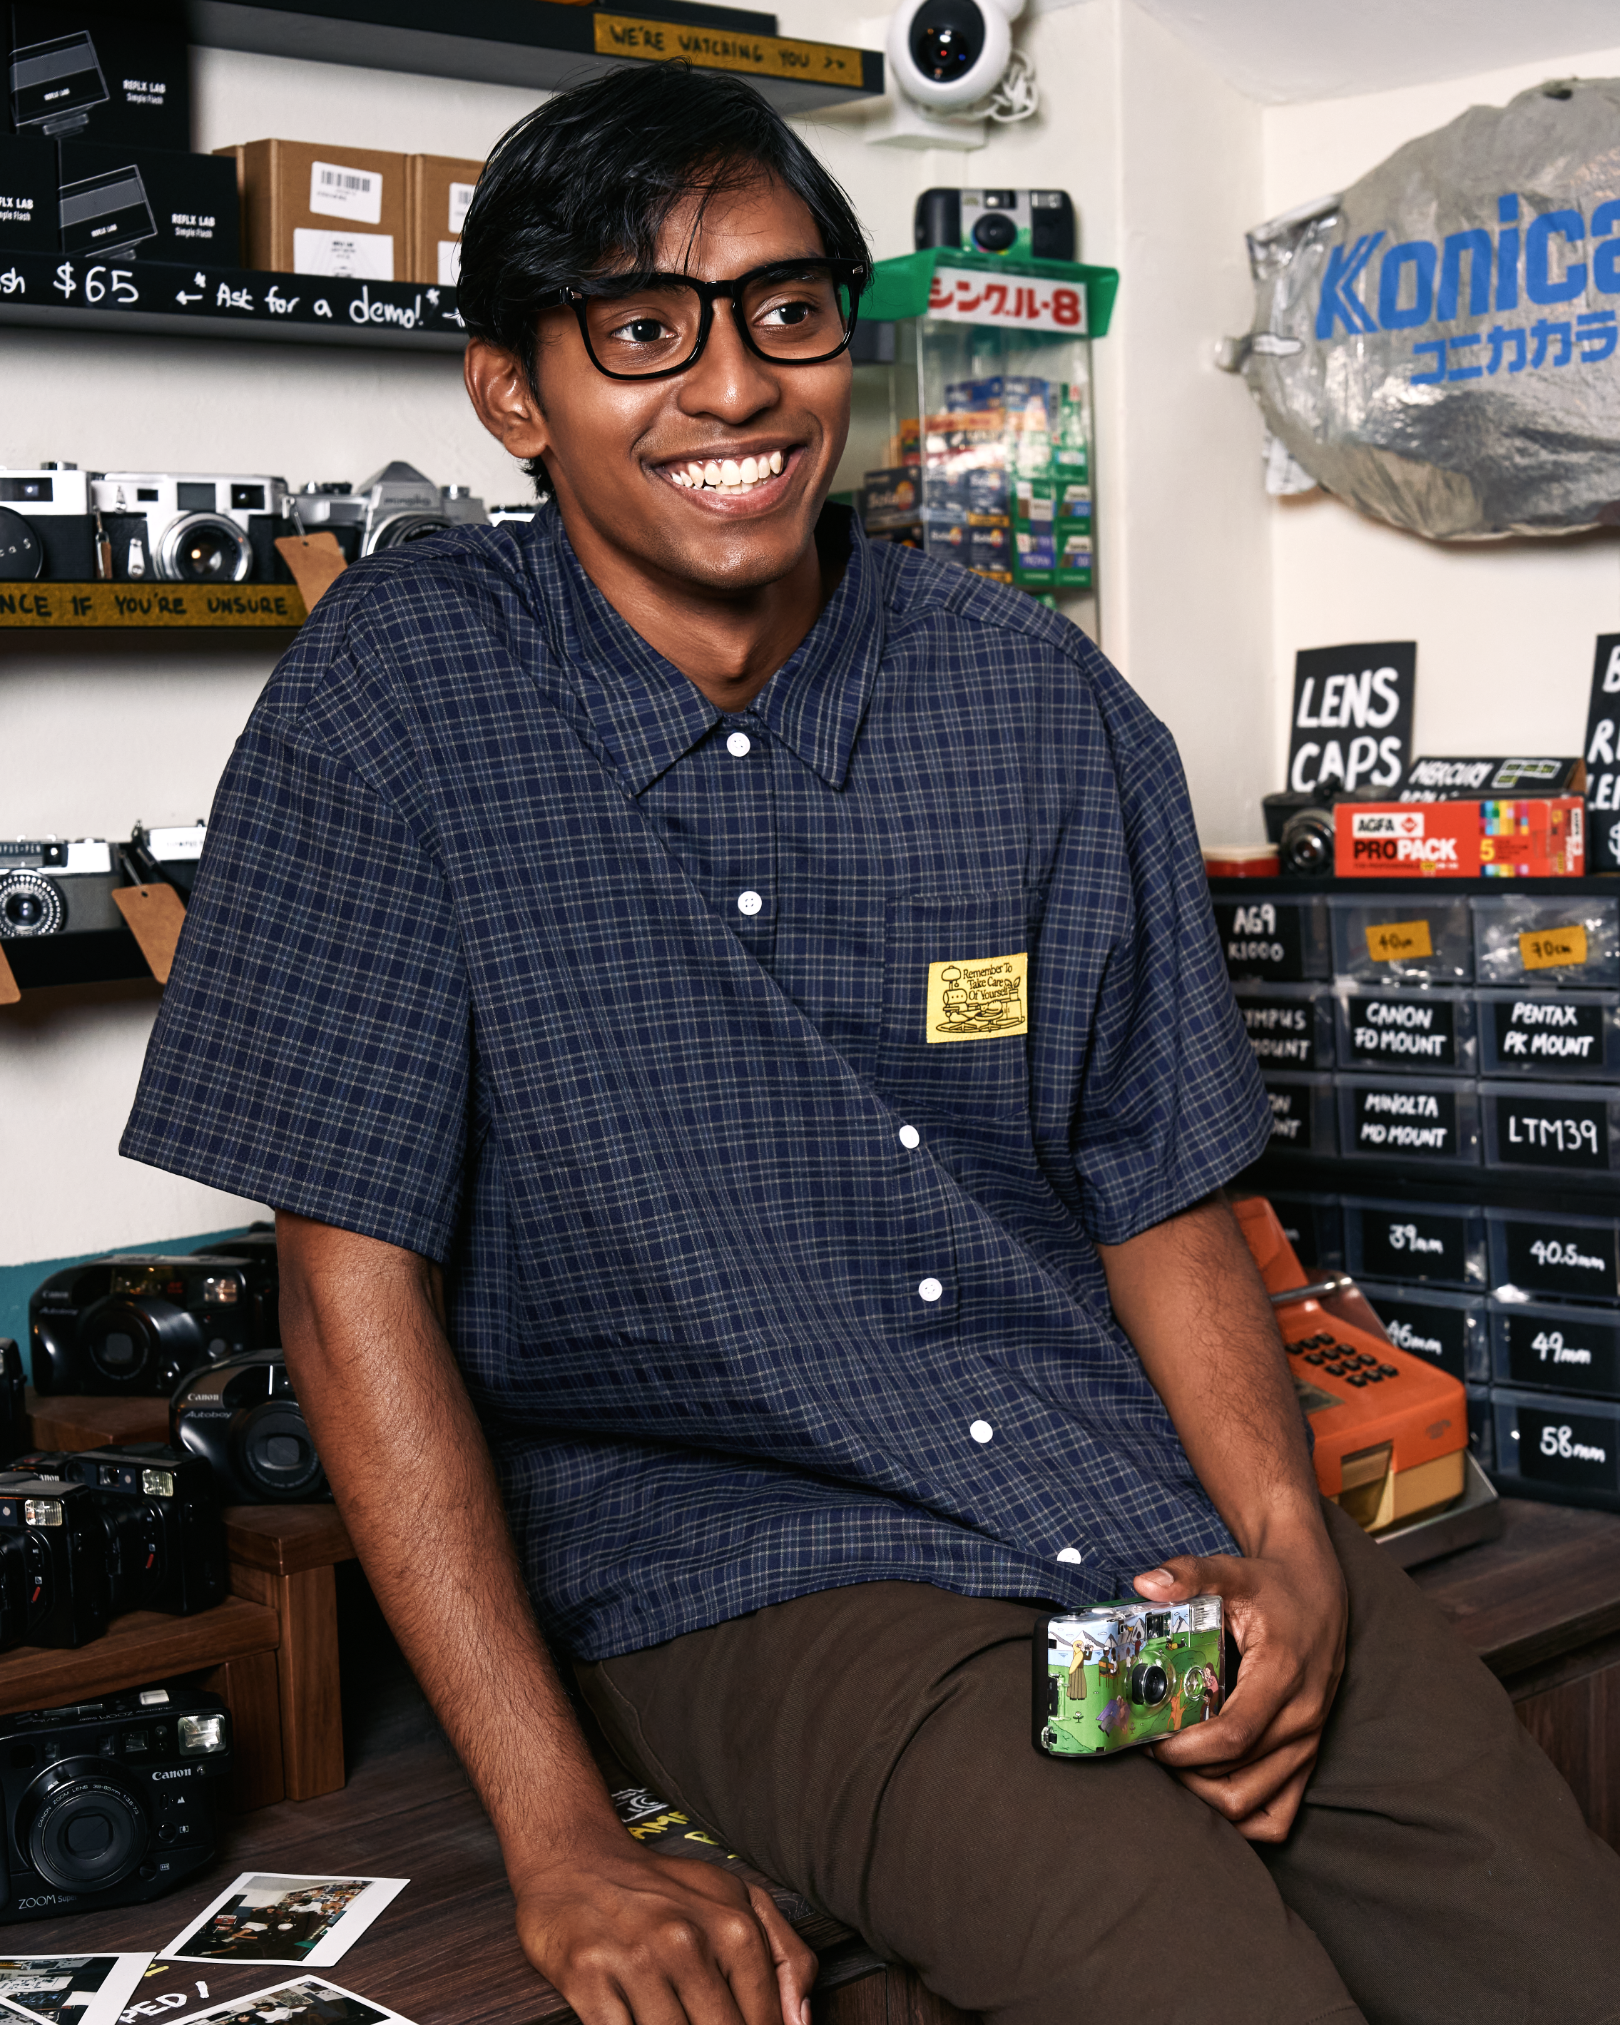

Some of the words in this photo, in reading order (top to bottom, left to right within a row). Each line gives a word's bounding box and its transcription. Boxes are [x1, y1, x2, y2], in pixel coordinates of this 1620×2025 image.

[678, 35, 763, 63] WATCHING
[778, 48, 810, 68] YOU
[53, 262, 140, 304] $65
[264, 286, 301, 316] for
[313, 299, 333, 319] a
[70, 595, 93, 617] IF
[114, 592, 188, 616] YOU'RE
[207, 596, 288, 616] UNSURE
[1296, 666, 1400, 729] LENS
[1291, 735, 1402, 793] CAPS
[1357, 818, 1396, 833] AGFA
[1353, 837, 1458, 862] PROPACK
[1480, 838, 1496, 862] 5
[963, 965, 1003, 980] Remember
[1004, 962, 1012, 973] To
[967, 978, 987, 990] Take
[987, 976, 1004, 988] Care
[968, 989, 980, 1001] Of
[1366, 1002, 1434, 1030] CANON
[1511, 1001, 1578, 1028] PENTAX
[1354, 1026, 1379, 1050] FD
[1380, 1029, 1448, 1058] MOUNT
[1504, 1030, 1529, 1055] PK
[1531, 1032, 1594, 1058] MOUNT
[1364, 1093, 1440, 1120] MINOLTA
[1360, 1122, 1386, 1144] MD
[1387, 1124, 1448, 1149] MOUNT
[1509, 1115, 1598, 1155] LTM39
[1529, 1239, 1606, 1272] 40.5mm
[1531, 1331, 1592, 1365] 49mm
[187, 1393, 220, 1401] Canon
[184, 1410, 232, 1419] Autoboy
[1540, 1425, 1606, 1464] 58mm
[151, 1768, 192, 1781] Canon
[37, 1806, 52, 1828] CANON
[53, 1790, 71, 1805] ZOOM
[71, 1783, 89, 1793] LENS
[18, 1894, 57, 1910] ZOOM
[57, 1894, 78, 1904] Super
